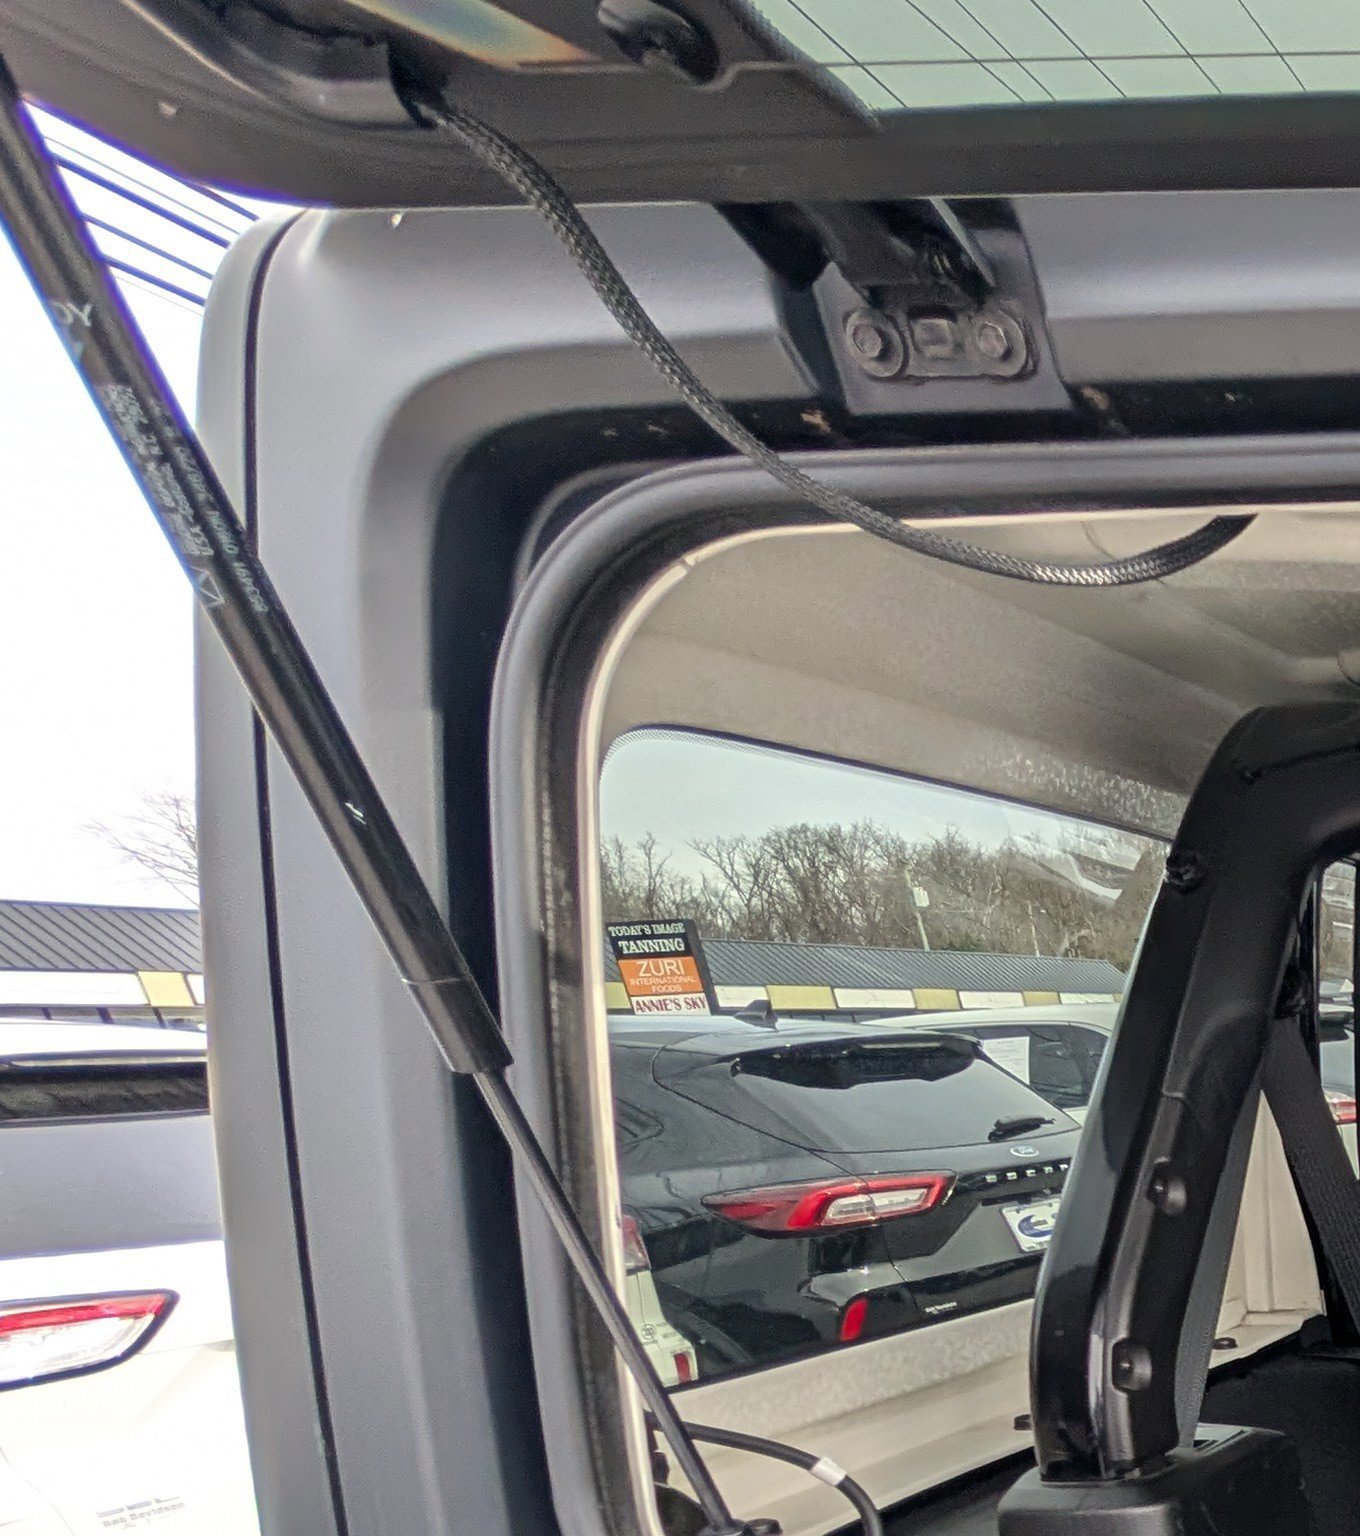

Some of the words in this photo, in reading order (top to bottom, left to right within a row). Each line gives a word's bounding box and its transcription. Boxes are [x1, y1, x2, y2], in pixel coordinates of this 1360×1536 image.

[608, 924, 651, 937] TODAY'S
[653, 922, 686, 935] IMAGE
[618, 938, 685, 955] TANNING
[636, 958, 685, 977] ZURI
[629, 975, 696, 986] INTERNATIONAL
[651, 985, 683, 993] FOODS
[635, 998, 682, 1013] ANNIE'S
